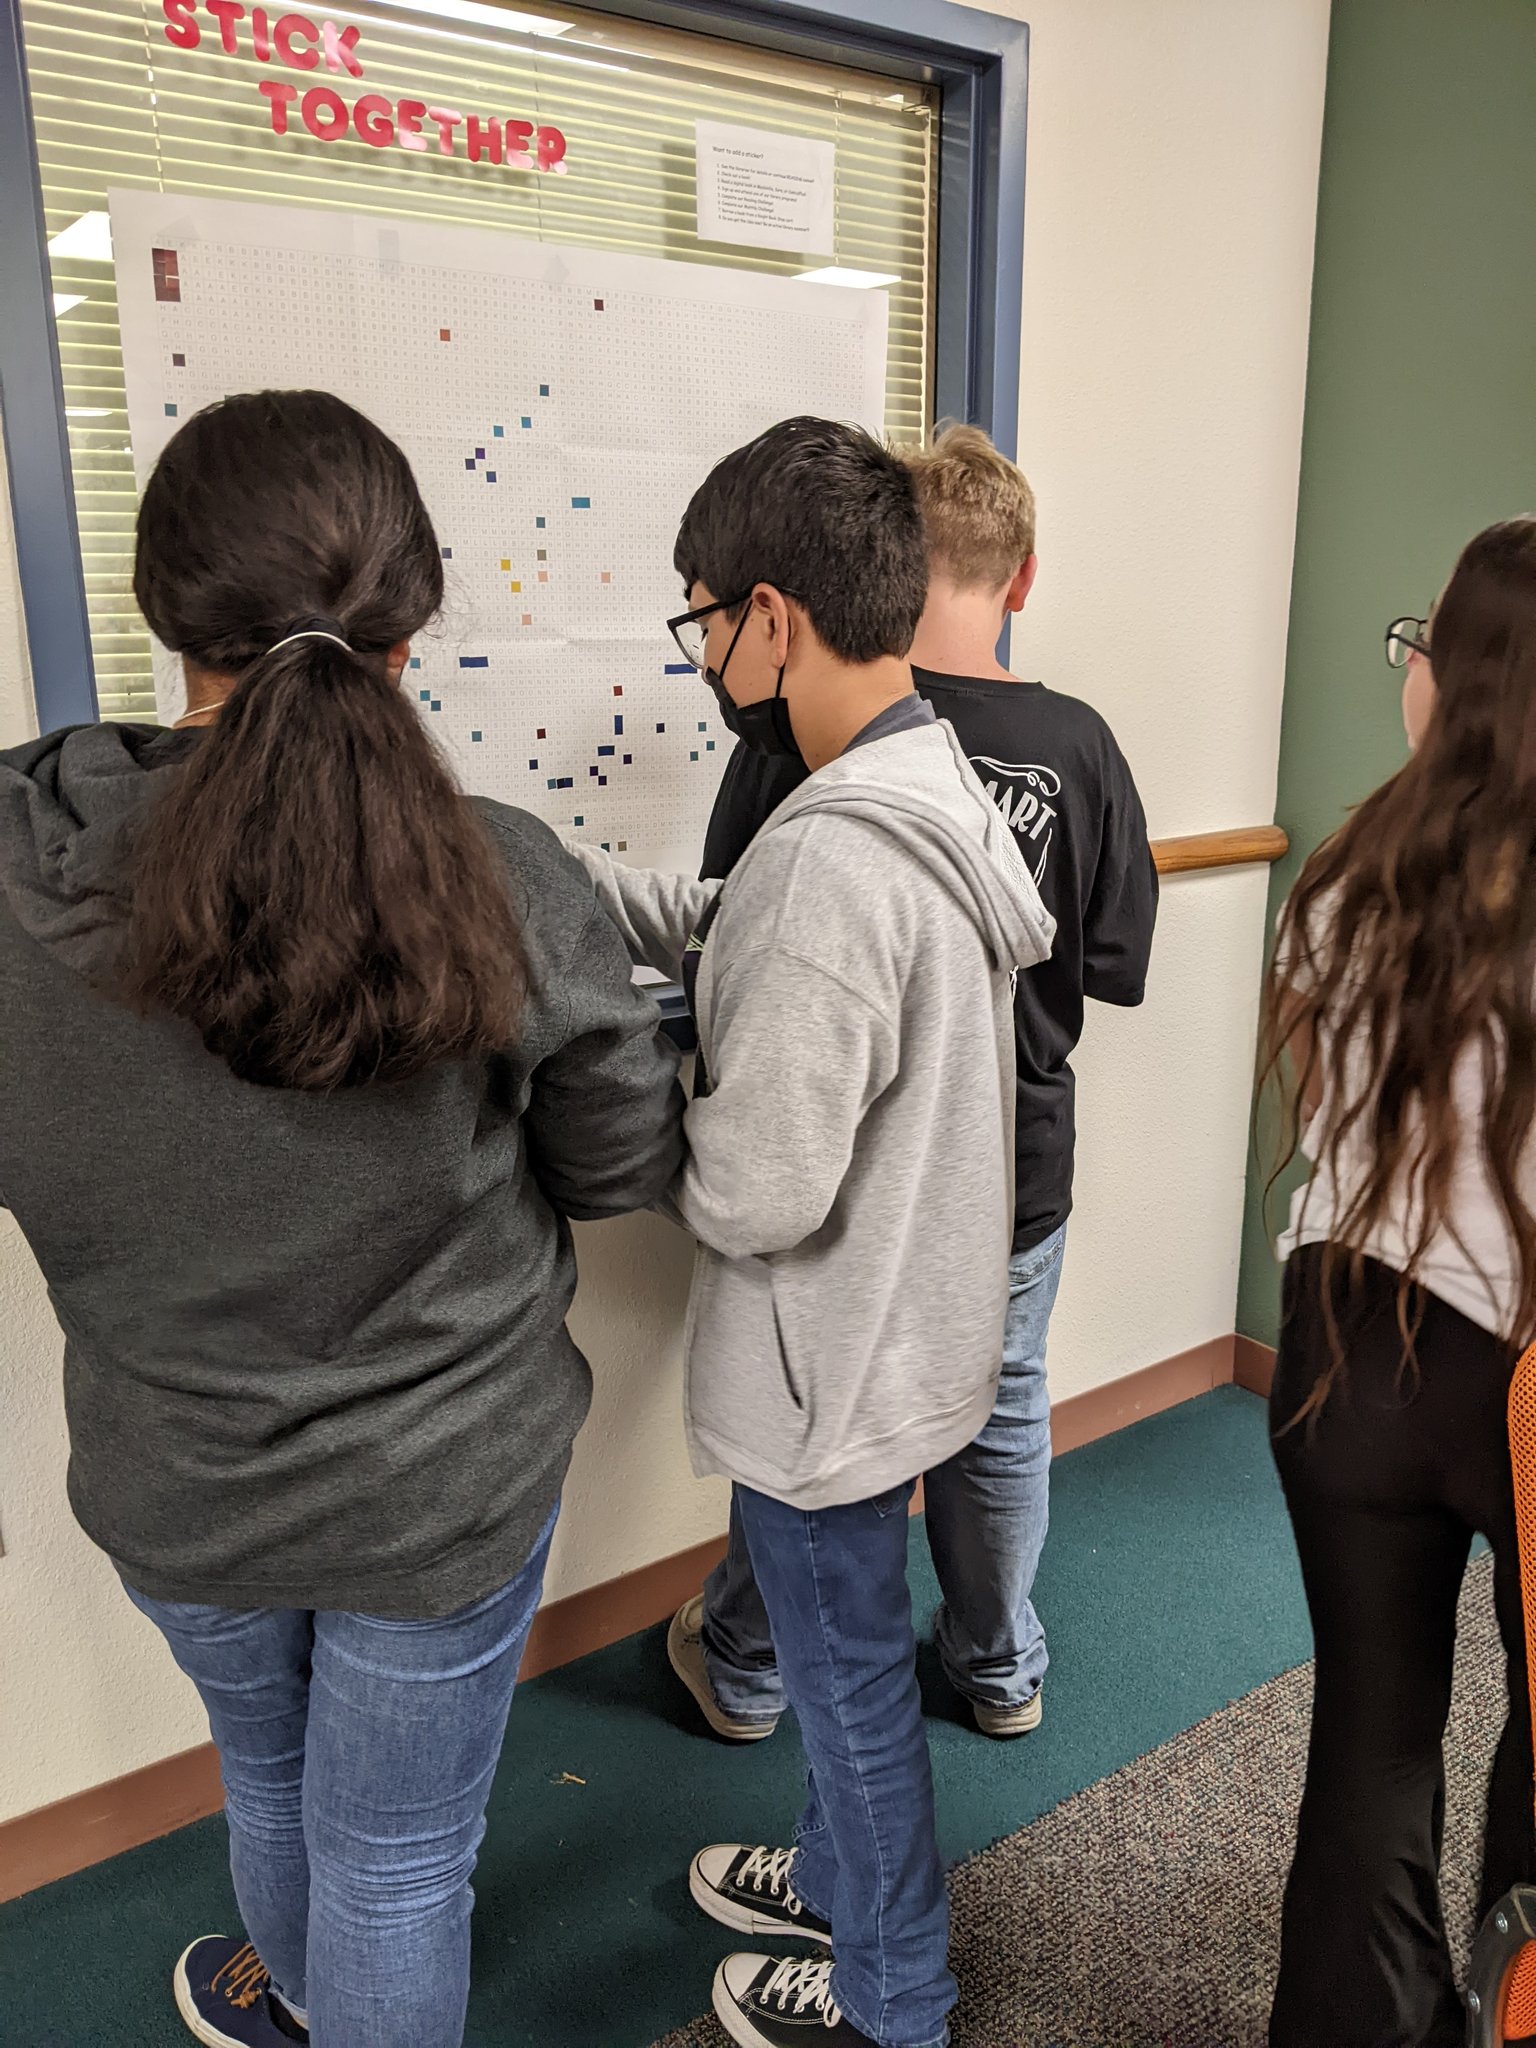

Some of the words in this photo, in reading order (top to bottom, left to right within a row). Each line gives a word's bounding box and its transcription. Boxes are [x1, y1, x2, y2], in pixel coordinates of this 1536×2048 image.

[164, 0, 364, 78] STICK
[258, 80, 569, 176] TOGETHER
[746, 152, 764, 160] sticker?
